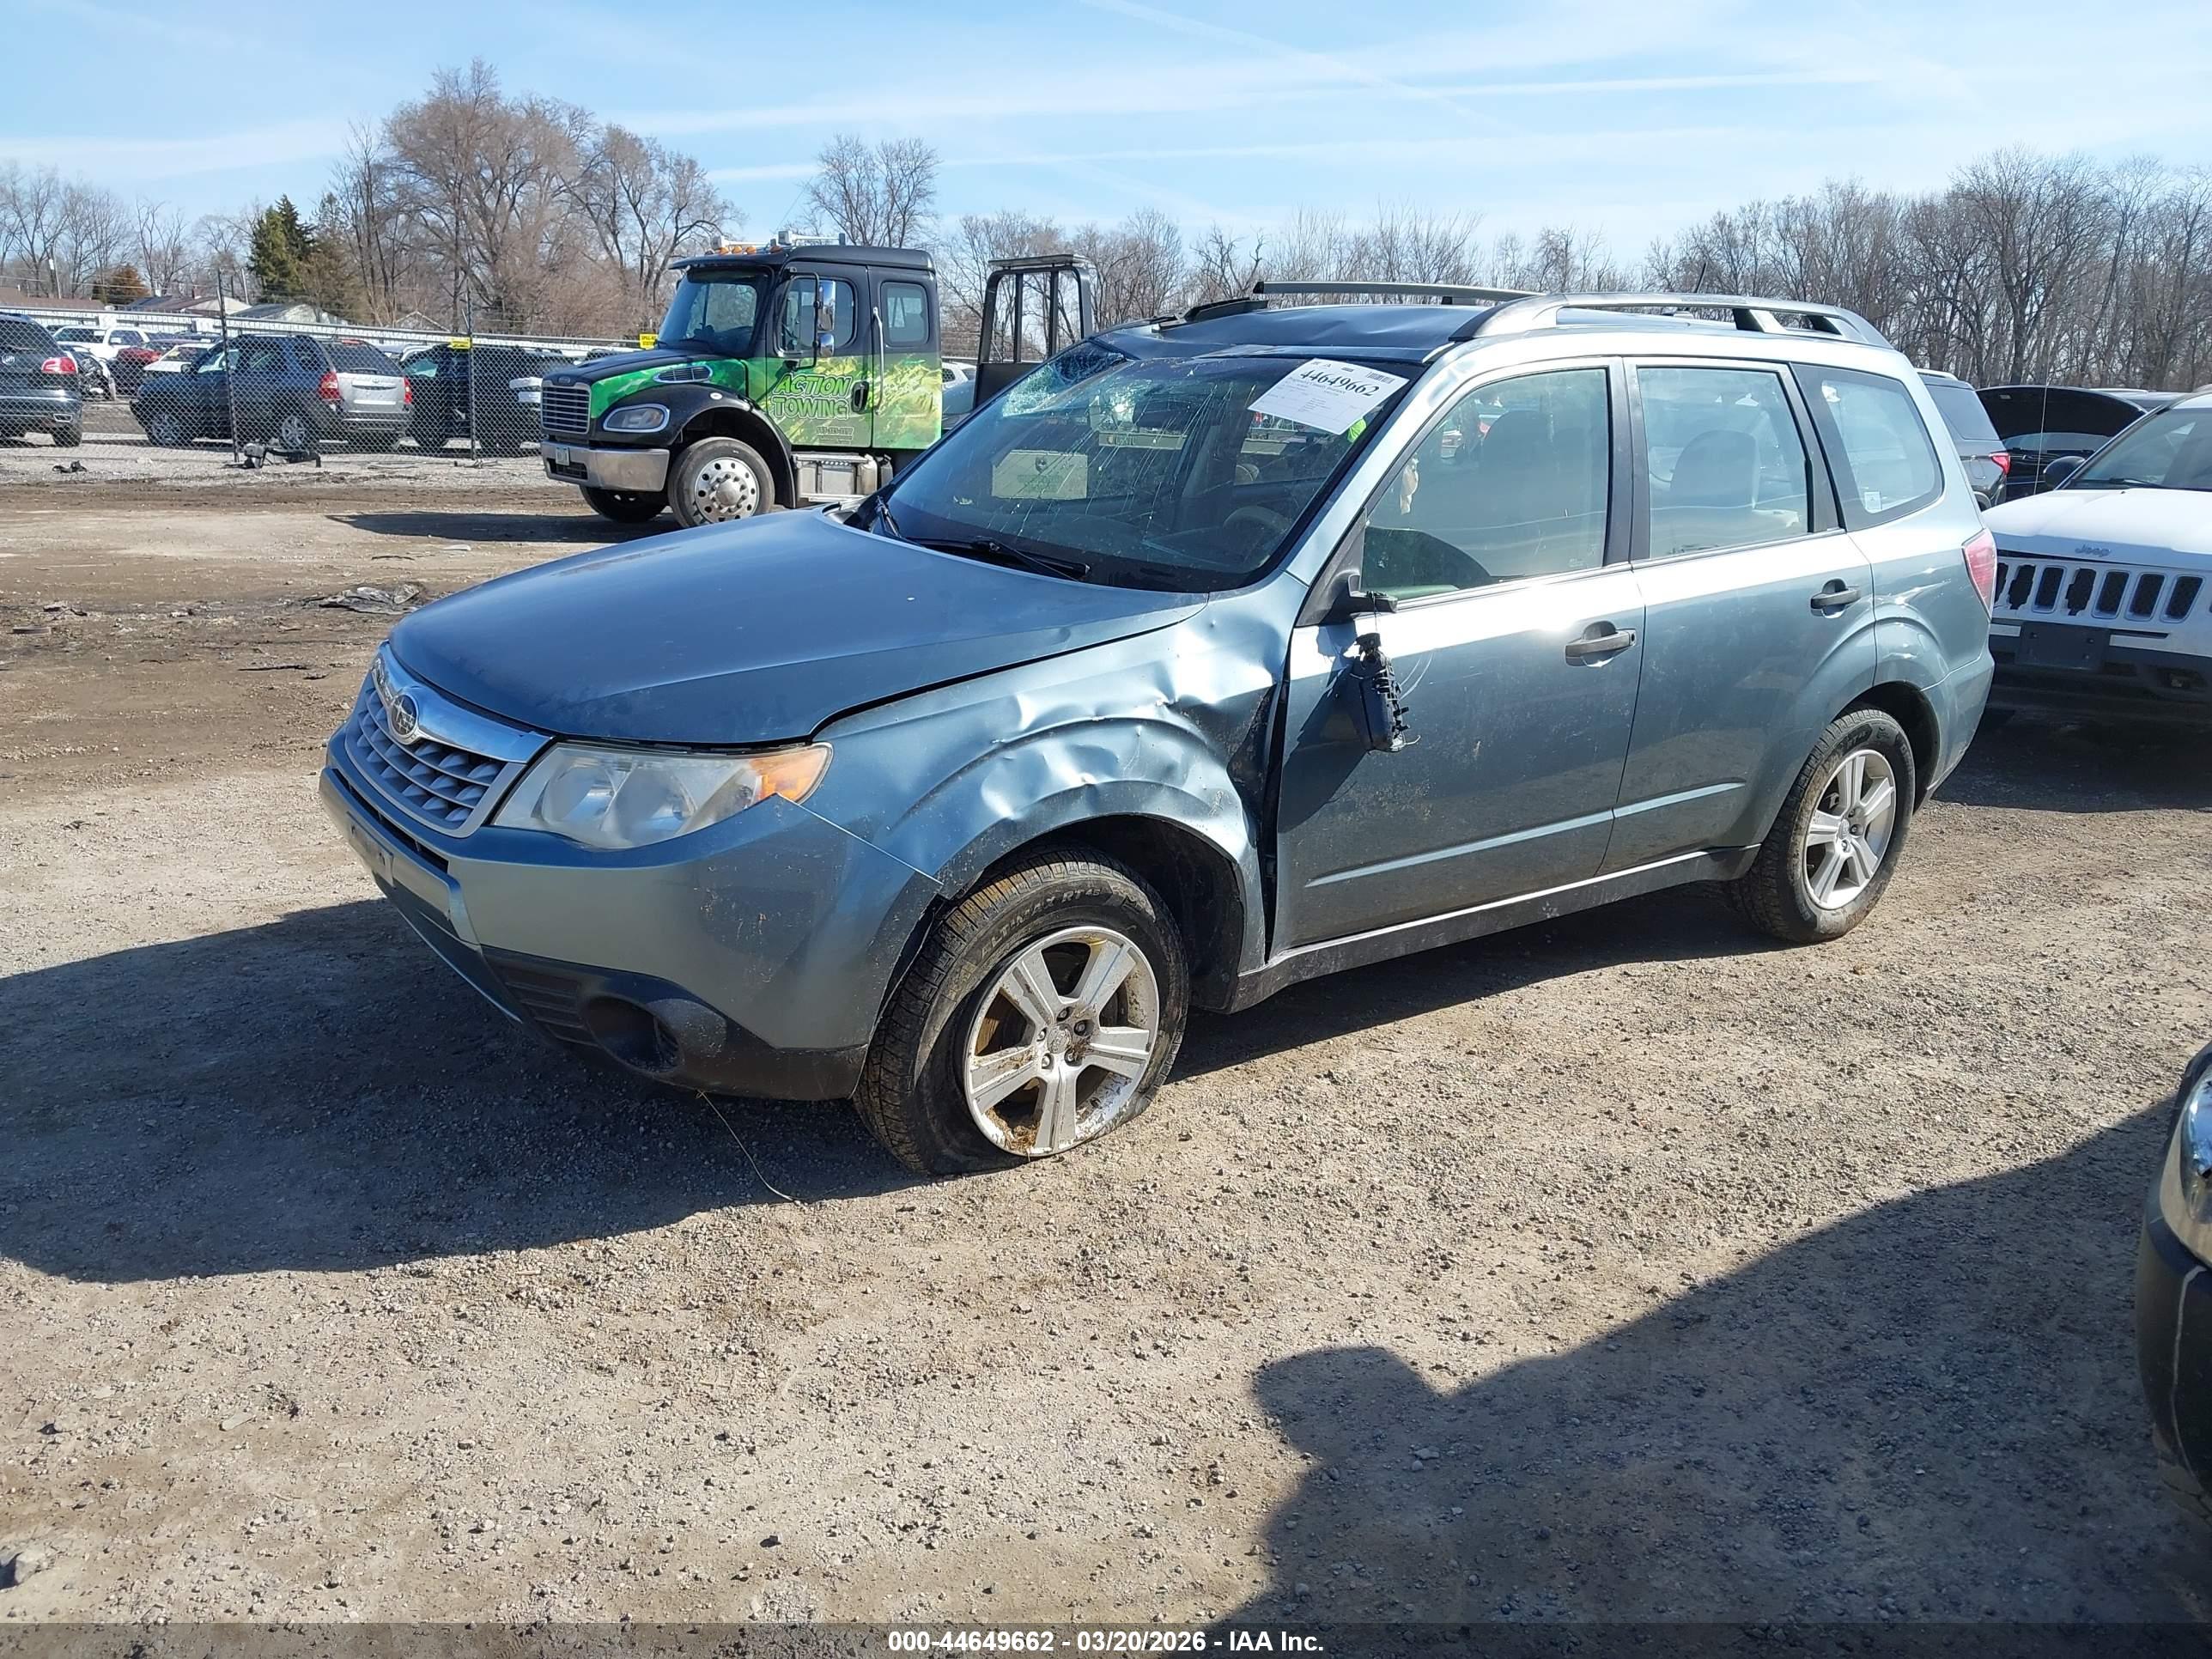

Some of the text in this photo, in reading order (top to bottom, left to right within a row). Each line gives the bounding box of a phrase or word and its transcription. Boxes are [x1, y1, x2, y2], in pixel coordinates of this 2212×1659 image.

[773, 373, 852, 398] ACTION
[1300, 368, 1380, 397] 44649662
[771, 396, 849, 420] TOWING
[2075, 544, 2112, 557] Jeep
